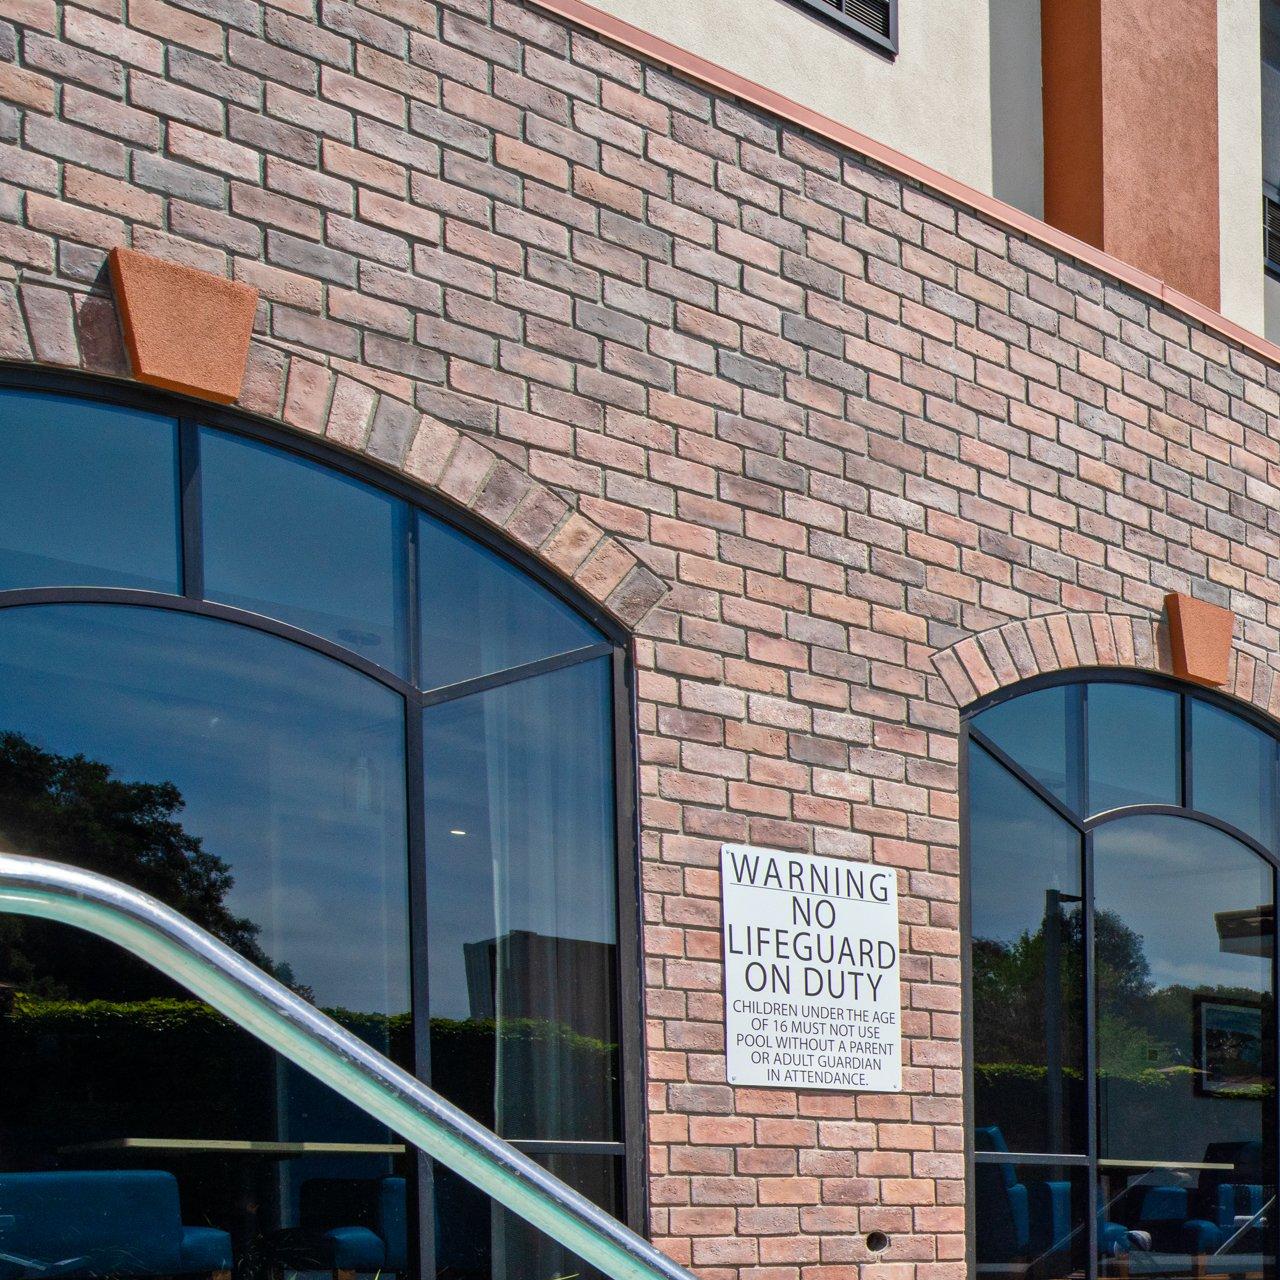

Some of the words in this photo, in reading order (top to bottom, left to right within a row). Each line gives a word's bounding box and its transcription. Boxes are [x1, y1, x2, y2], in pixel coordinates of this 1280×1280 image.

[731, 853, 888, 902] WARNING
[793, 896, 836, 929] NO
[729, 924, 896, 969] LIFEGUARD
[745, 961, 790, 994] ON
[804, 967, 883, 1002] DUTY
[733, 1000, 798, 1017] CHILDREN
[801, 1005, 844, 1020] UNDER
[846, 1009, 869, 1023] THE
[872, 1011, 896, 1025] AGE
[751, 1018, 768, 1031] OF
[773, 1020, 788, 1033] 16
[791, 1021, 826, 1035] MUST
[829, 1023, 855, 1037] NOT
[858, 1026, 880, 1039] USE
[736, 1033, 772, 1048] POOL
[775, 1036, 835, 1052] WITHOUT
[838, 1041, 847, 1052] A
[850, 1041, 894, 1056] PARENT
[751, 1051, 770, 1065] OR
[773, 1052, 814, 1067] ADULT
[818, 1055, 882, 1071] GUARDIAN
[767, 1069, 780, 1081] IN
[784, 1069, 869, 1086] ATTENDANCE.
